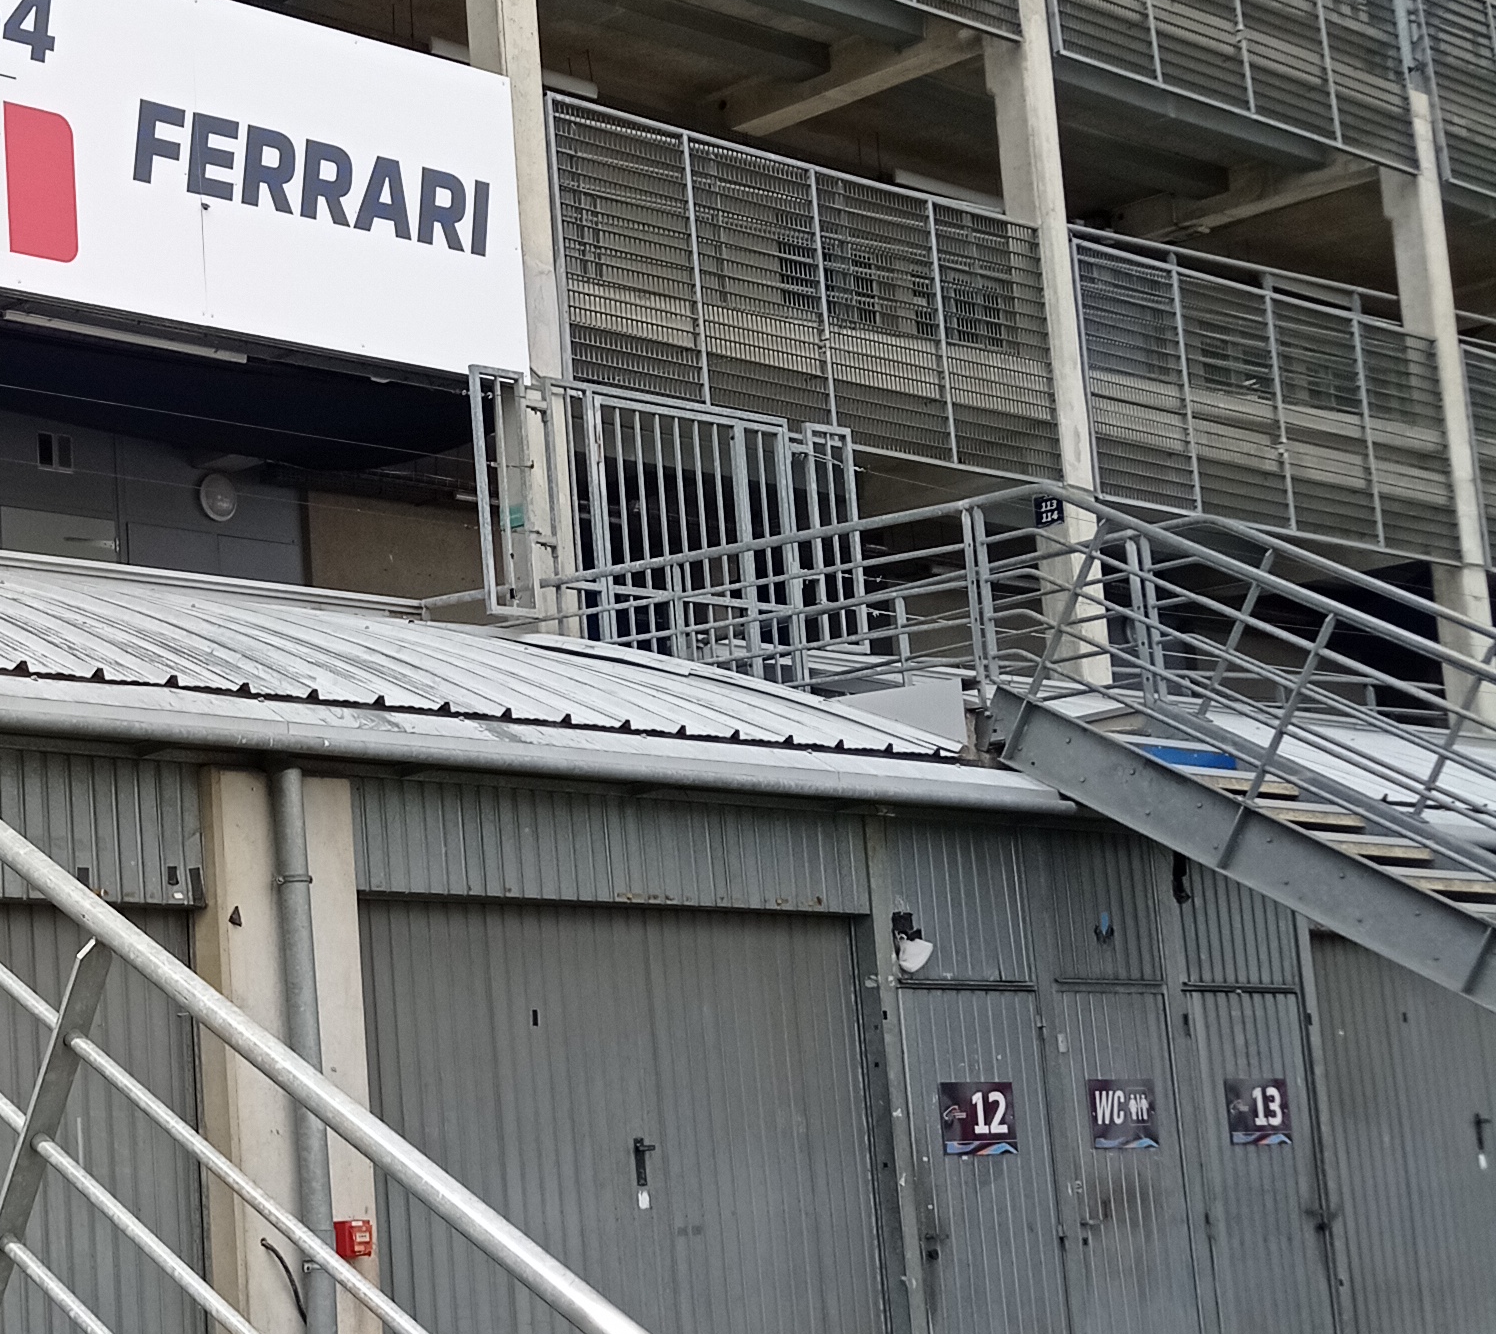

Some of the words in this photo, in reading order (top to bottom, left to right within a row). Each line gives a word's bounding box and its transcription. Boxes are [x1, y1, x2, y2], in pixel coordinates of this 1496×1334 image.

[133, 98, 490, 257] FERRARI
[1041, 499, 1057, 512] 113
[971, 1091, 1008, 1134] 12
[1095, 1090, 1125, 1125] WC
[1252, 1087, 1282, 1126] 13
